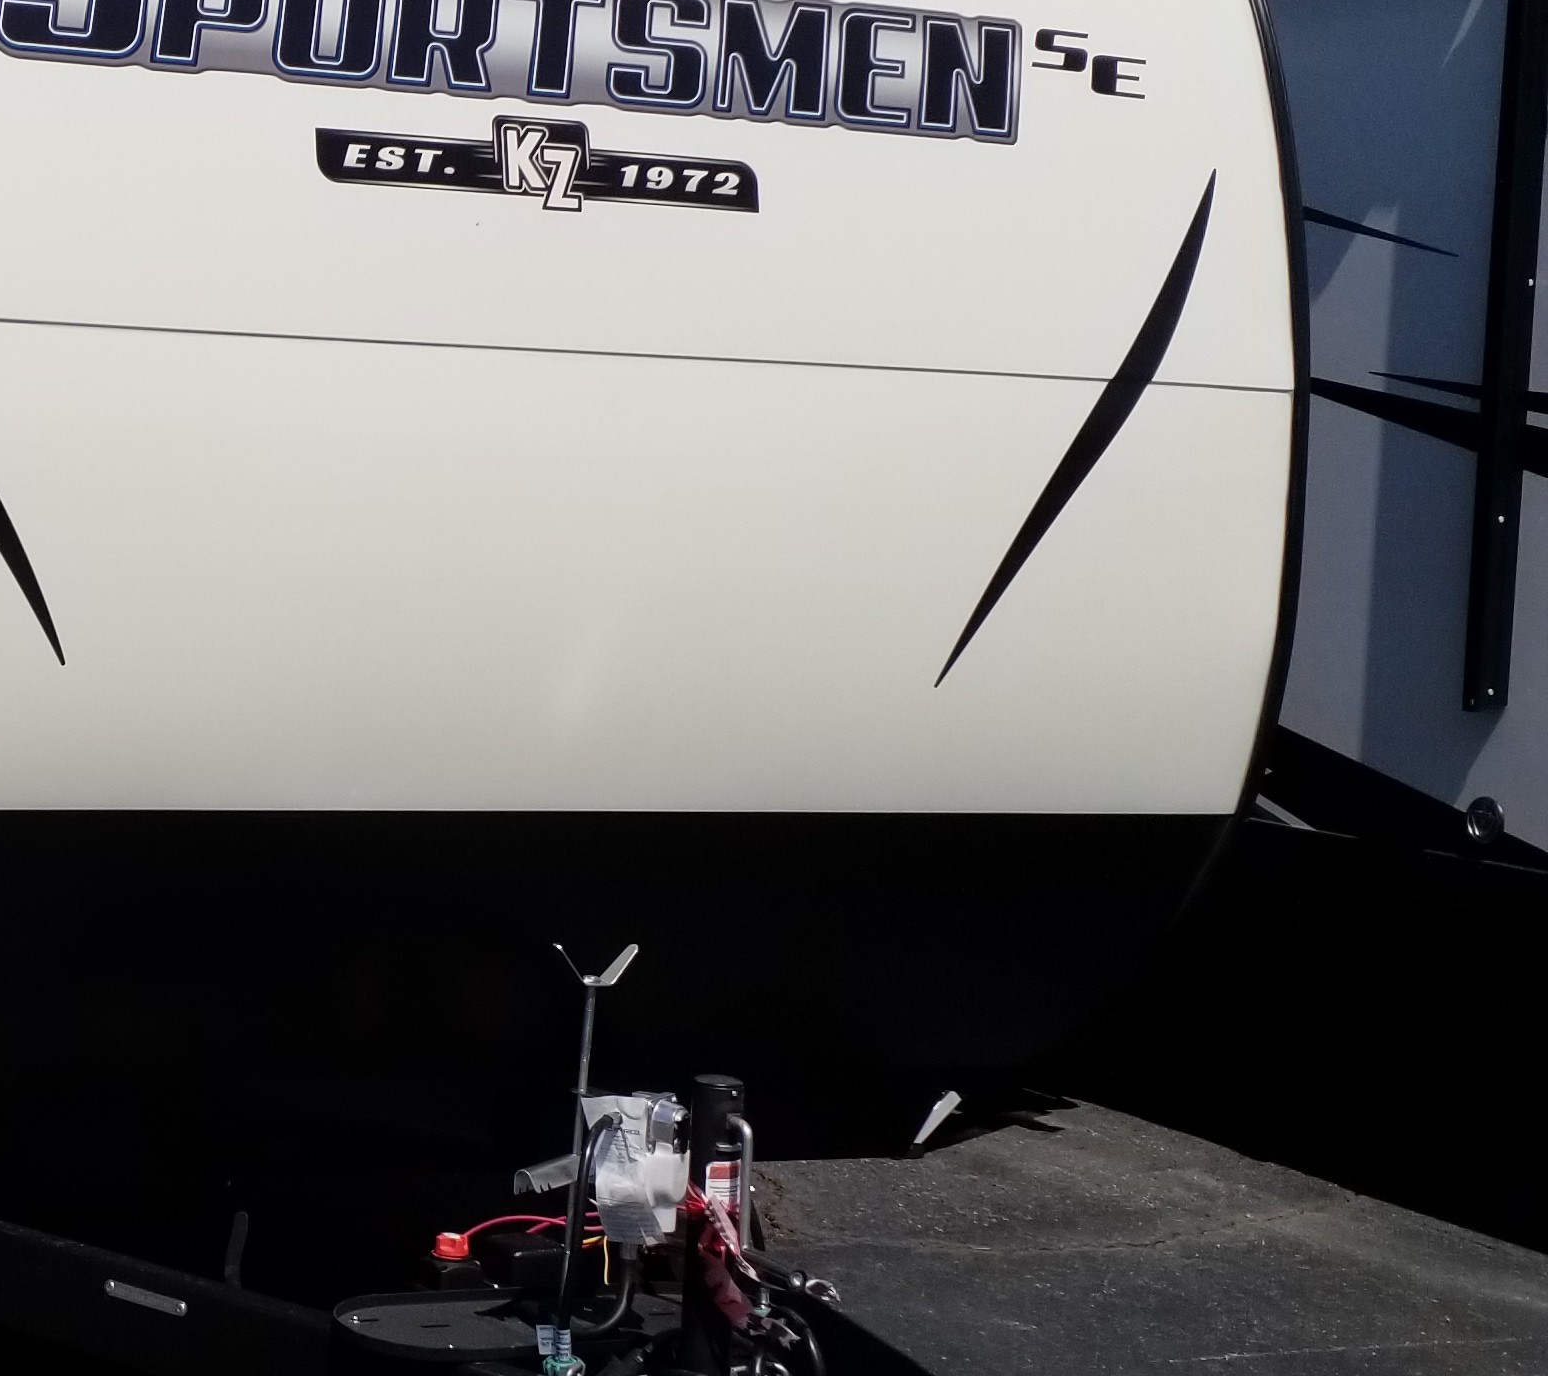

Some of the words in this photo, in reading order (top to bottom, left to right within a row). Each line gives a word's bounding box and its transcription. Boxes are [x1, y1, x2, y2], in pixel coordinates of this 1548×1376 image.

[1032, 28, 1146, 99] SE
[342, 142, 456, 175] EST.
[502, 123, 583, 212] KZ
[619, 164, 741, 197] 1972
